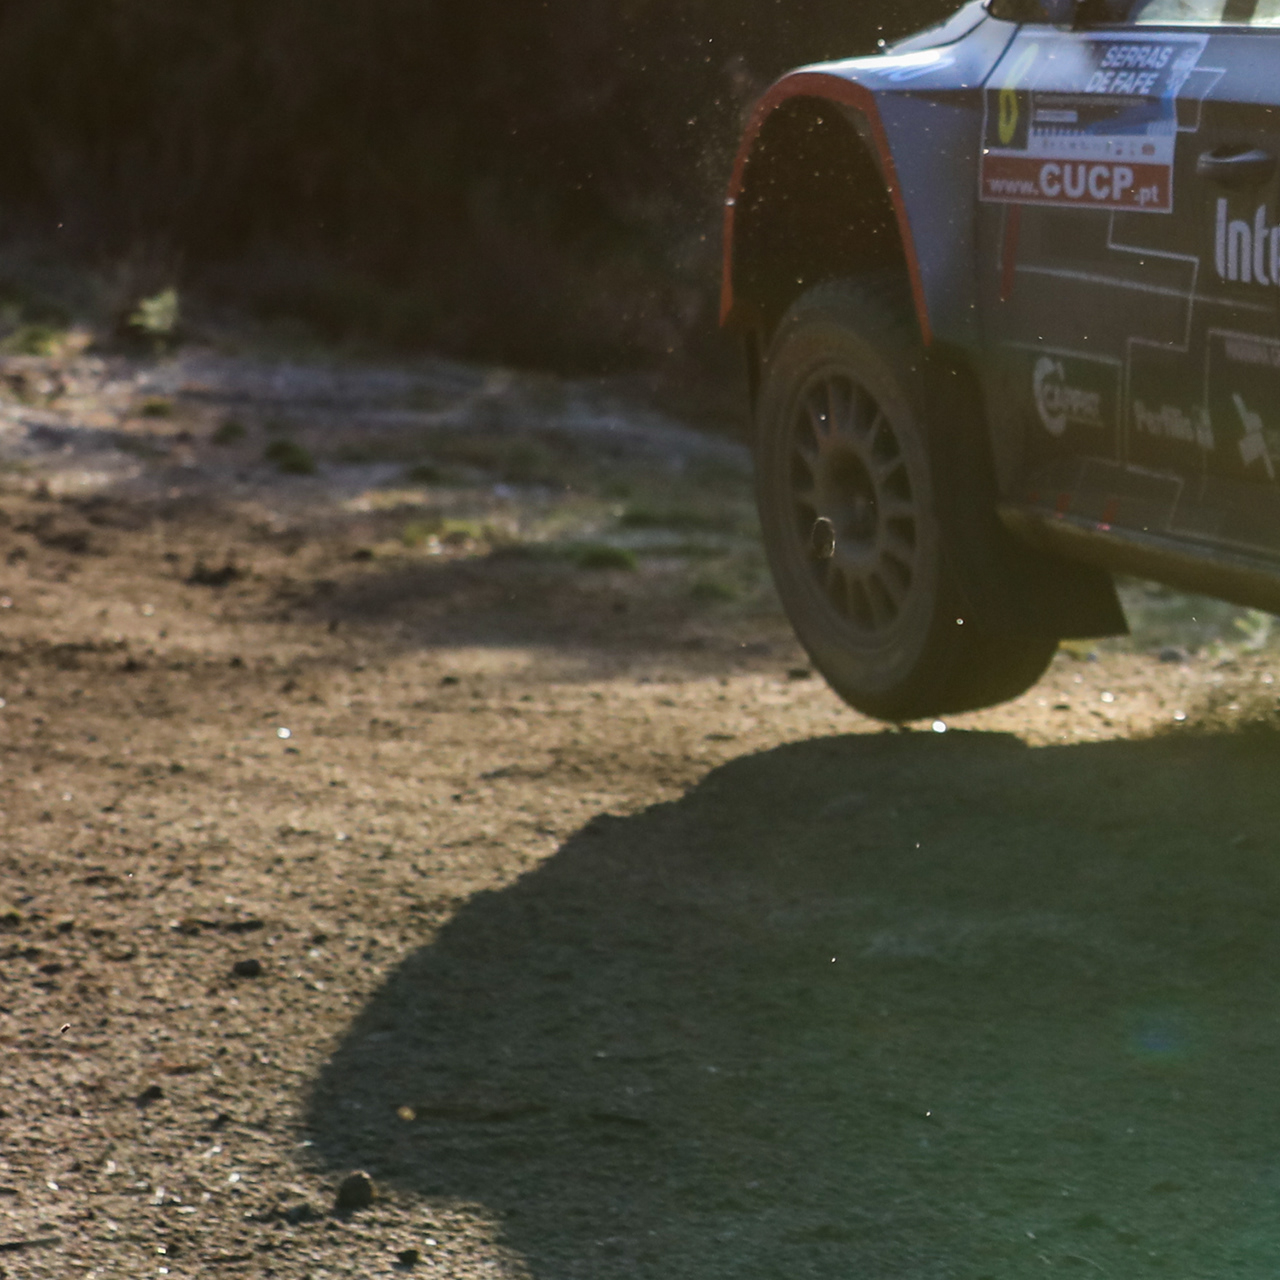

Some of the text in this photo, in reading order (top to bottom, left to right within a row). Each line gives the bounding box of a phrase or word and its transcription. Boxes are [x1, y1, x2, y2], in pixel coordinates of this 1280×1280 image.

[1101, 46, 1174, 70] SERRAS
[1085, 71, 1110, 93] DE
[1110, 72, 1160, 94] FAFE
